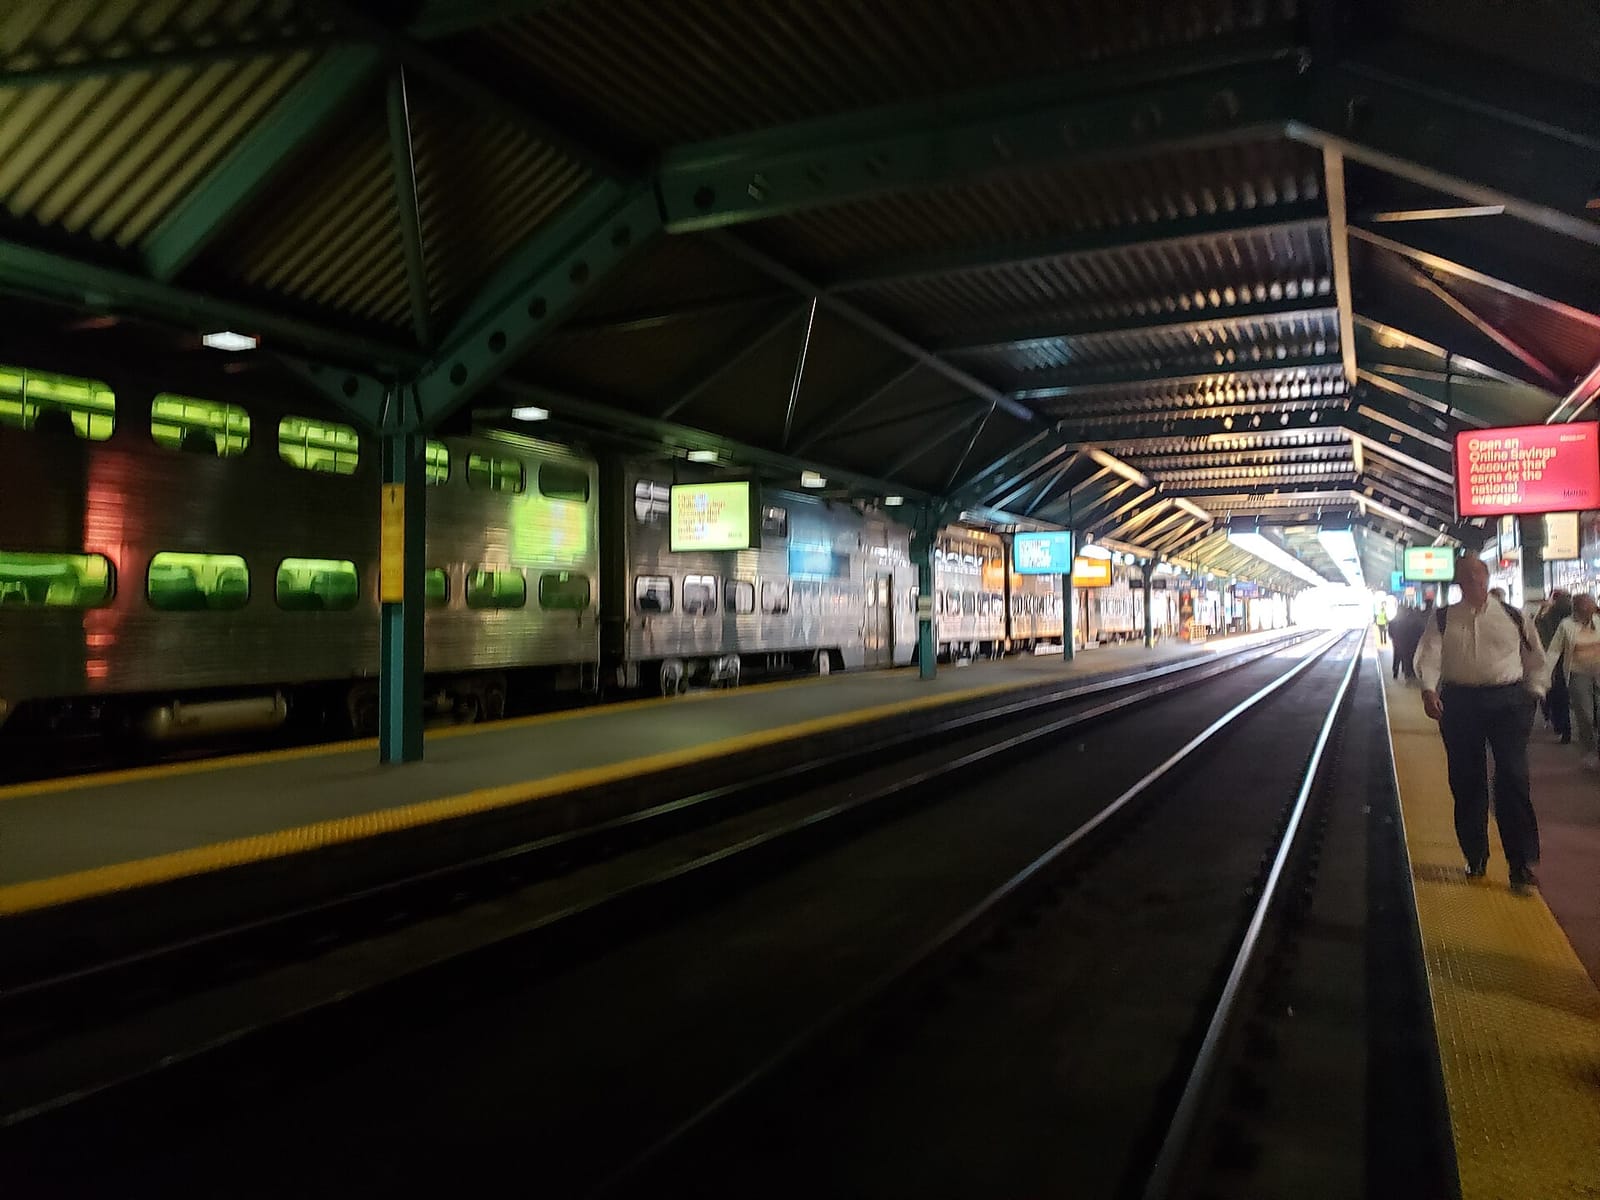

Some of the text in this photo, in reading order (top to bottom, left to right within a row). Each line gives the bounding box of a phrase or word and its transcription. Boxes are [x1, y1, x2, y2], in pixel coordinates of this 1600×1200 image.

[1468, 438, 1519, 452] Open an
[1469, 446, 1557, 463] Online Savings
[1470, 458, 1547, 474] Account that
[1470, 472, 1502, 484] earns
[1522, 469, 1542, 481] the
[1471, 481, 1518, 494] national
